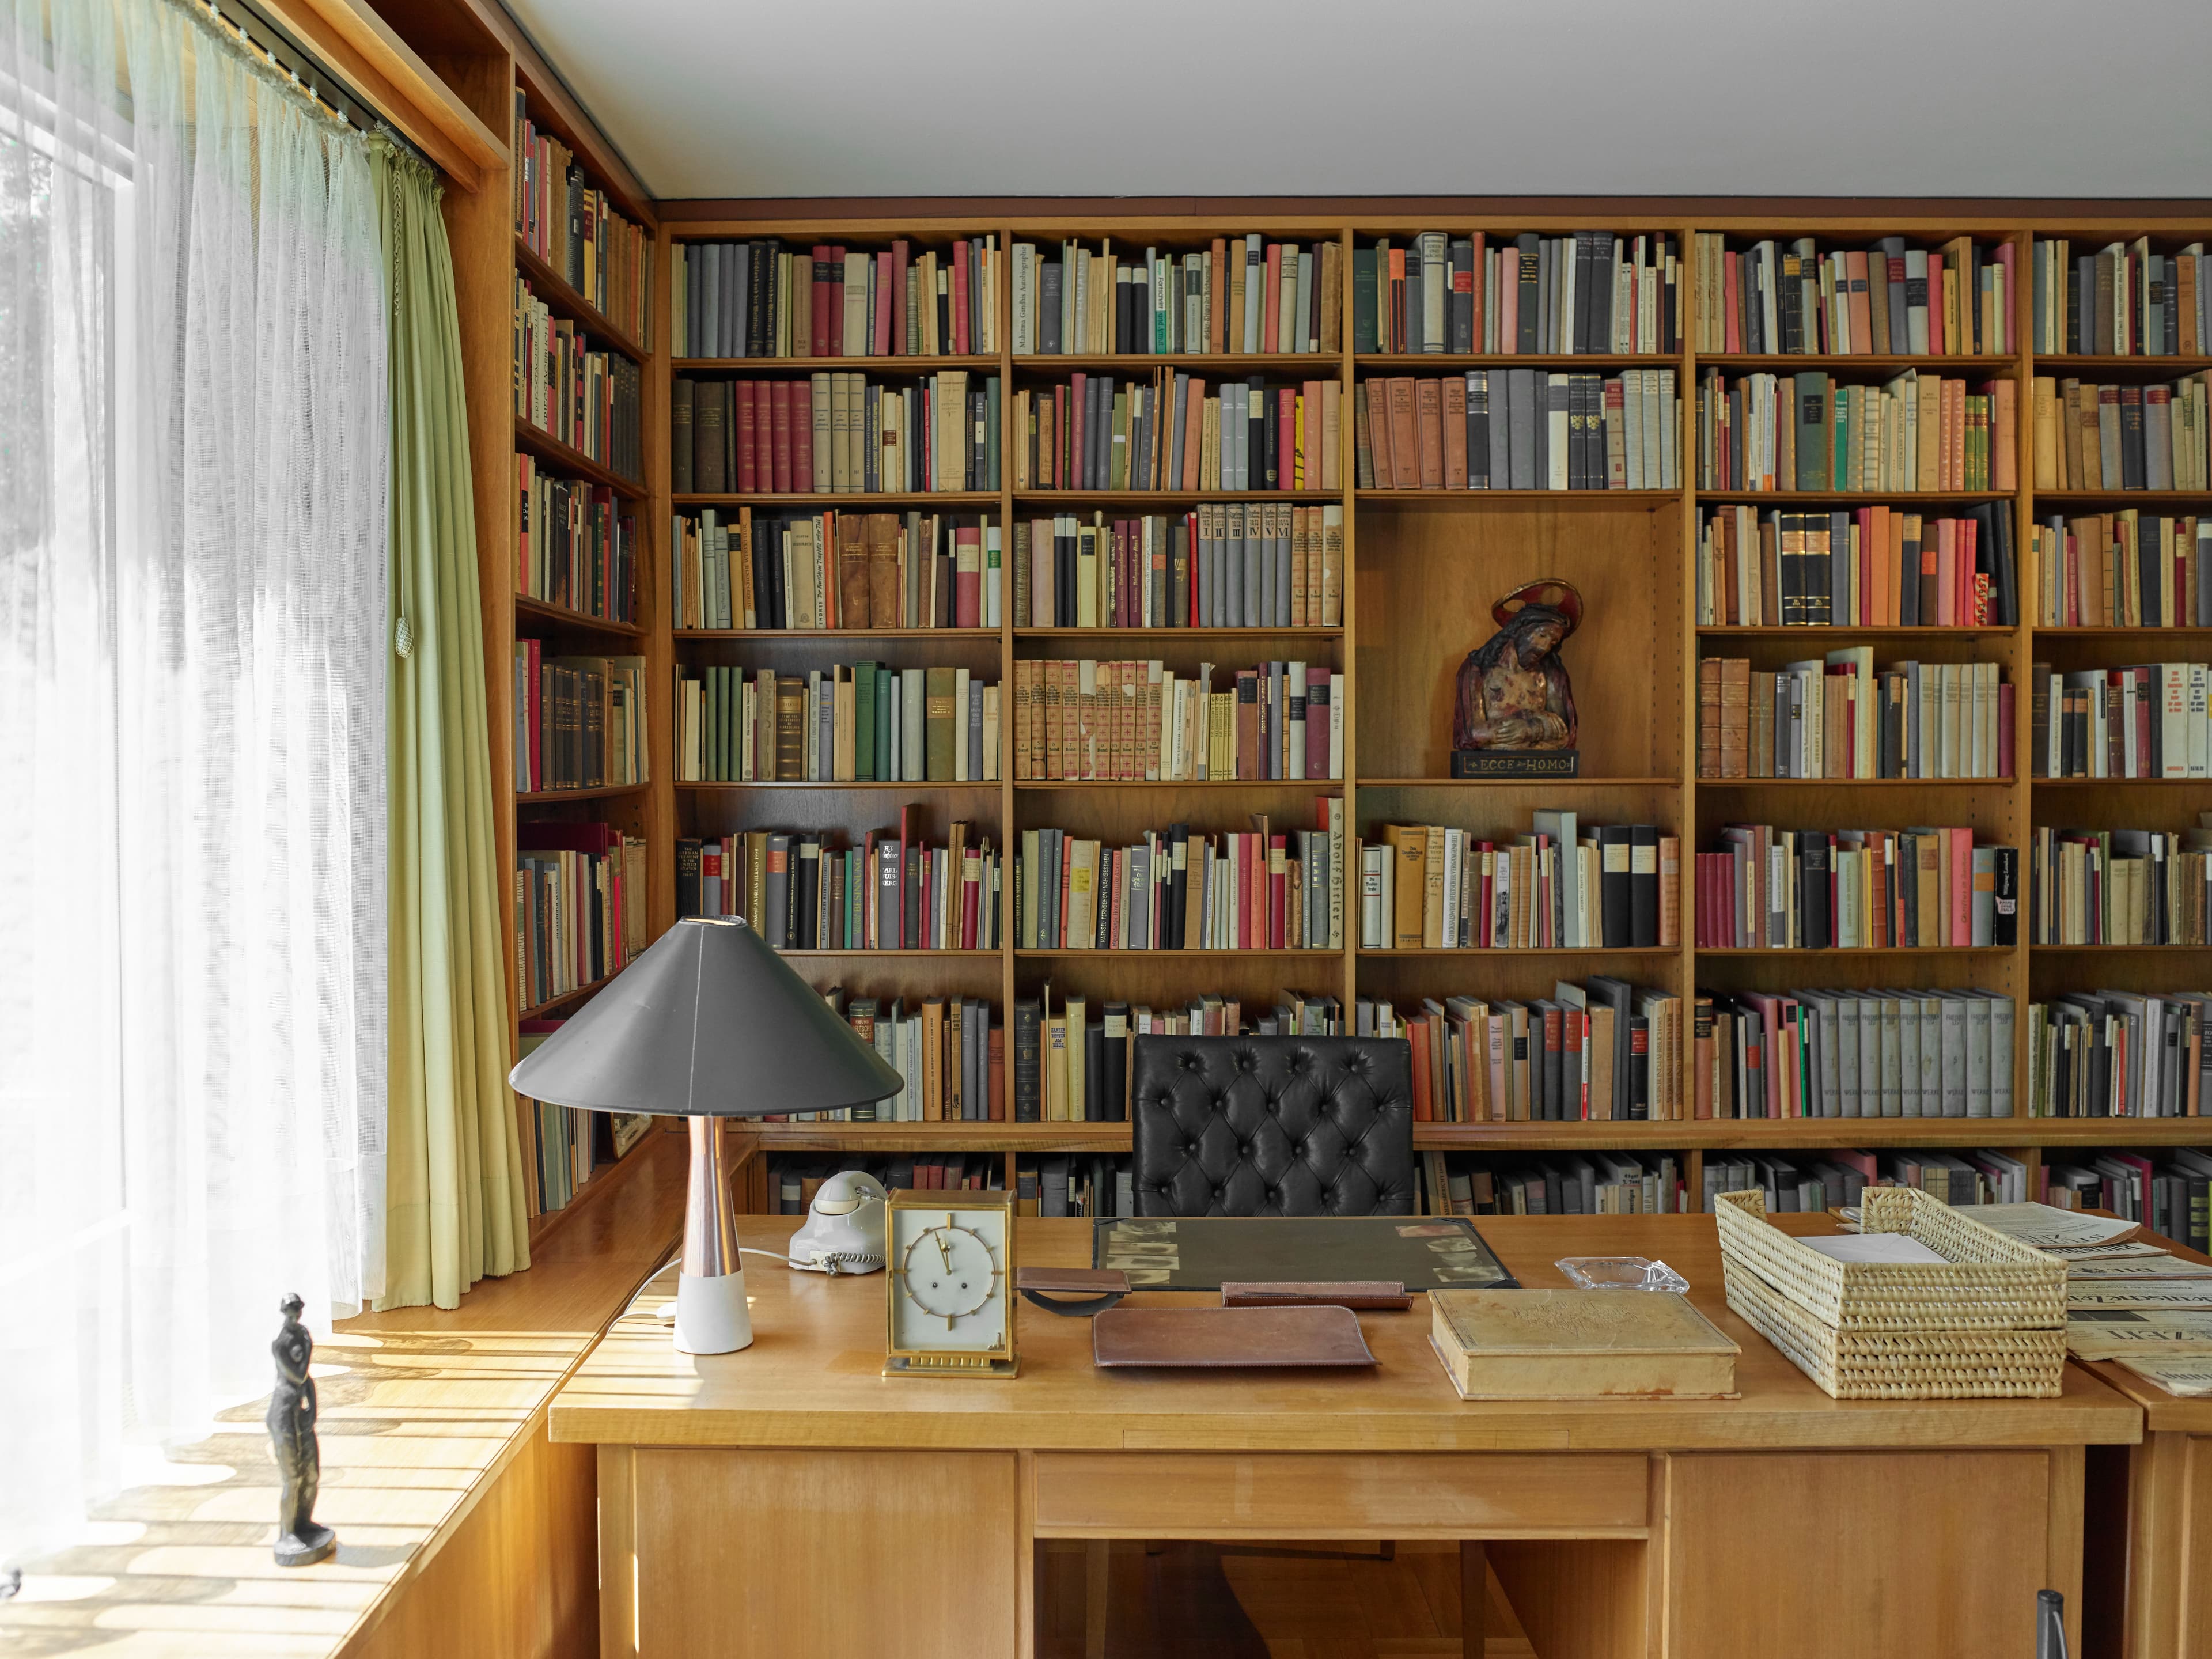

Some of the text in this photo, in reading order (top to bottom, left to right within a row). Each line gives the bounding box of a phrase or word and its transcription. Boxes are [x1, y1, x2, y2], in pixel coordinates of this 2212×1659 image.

[1018, 246, 1028, 348] Mahatma Gandhis Autobiographie
[1205, 527, 1209, 536] I
[1215, 528, 1223, 537] II
[1249, 527, 1259, 536] IV
[1266, 527, 1274, 536] V
[1278, 527, 1289, 537] VI
[1978, 578, 1988, 624] 1953-1957
[1480, 759, 1568, 771] ECCE HOMO
[1331, 831, 1342, 921] Adolf Hitler
[853, 857, 862, 913] BESINNUNG
[1448, 902, 1456, 942] SCHICKSALSWEGE
[2018, 1233, 2105, 1244] STUTTG
[2107, 1330, 2195, 1340] ZEIT
